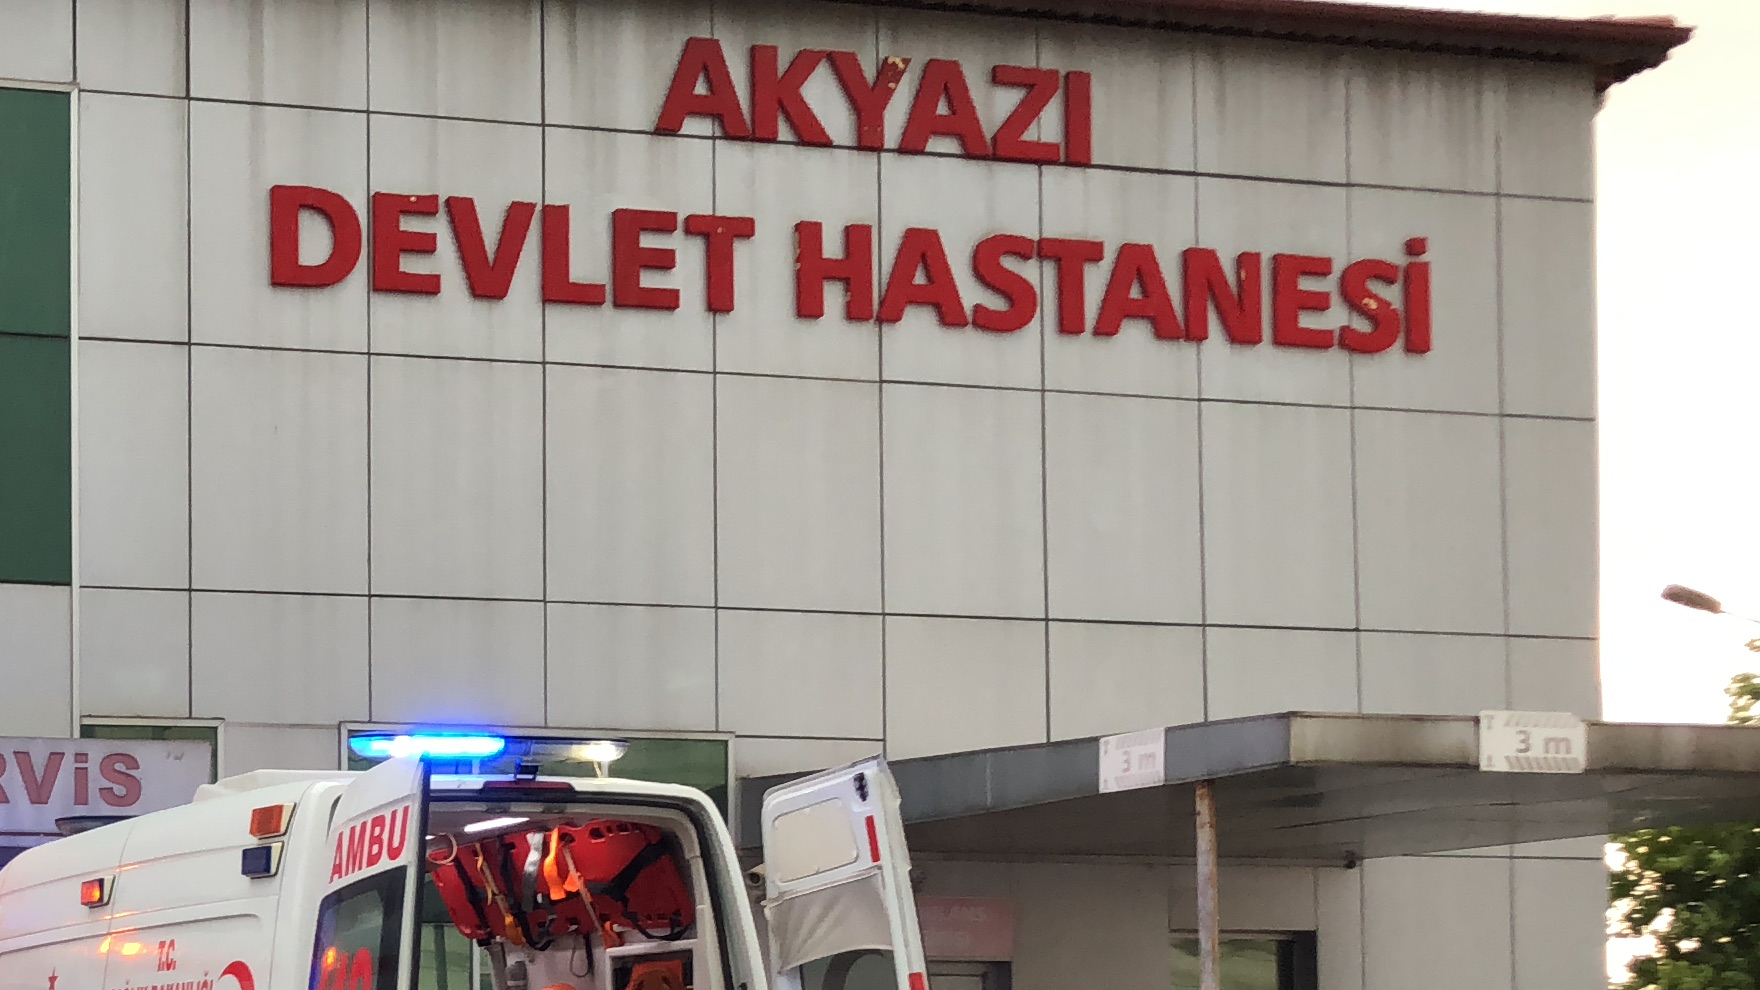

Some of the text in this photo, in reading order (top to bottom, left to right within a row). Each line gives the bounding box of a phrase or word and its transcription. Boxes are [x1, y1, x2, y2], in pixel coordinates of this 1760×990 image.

[653, 36, 1093, 166] AKYAZI
[268, 184, 1433, 355] DEVLET HASTANESİ
[1515, 730, 1531, 753] 3
[329, 805, 410, 884] AMBU
[157, 939, 177, 972] T.C.
